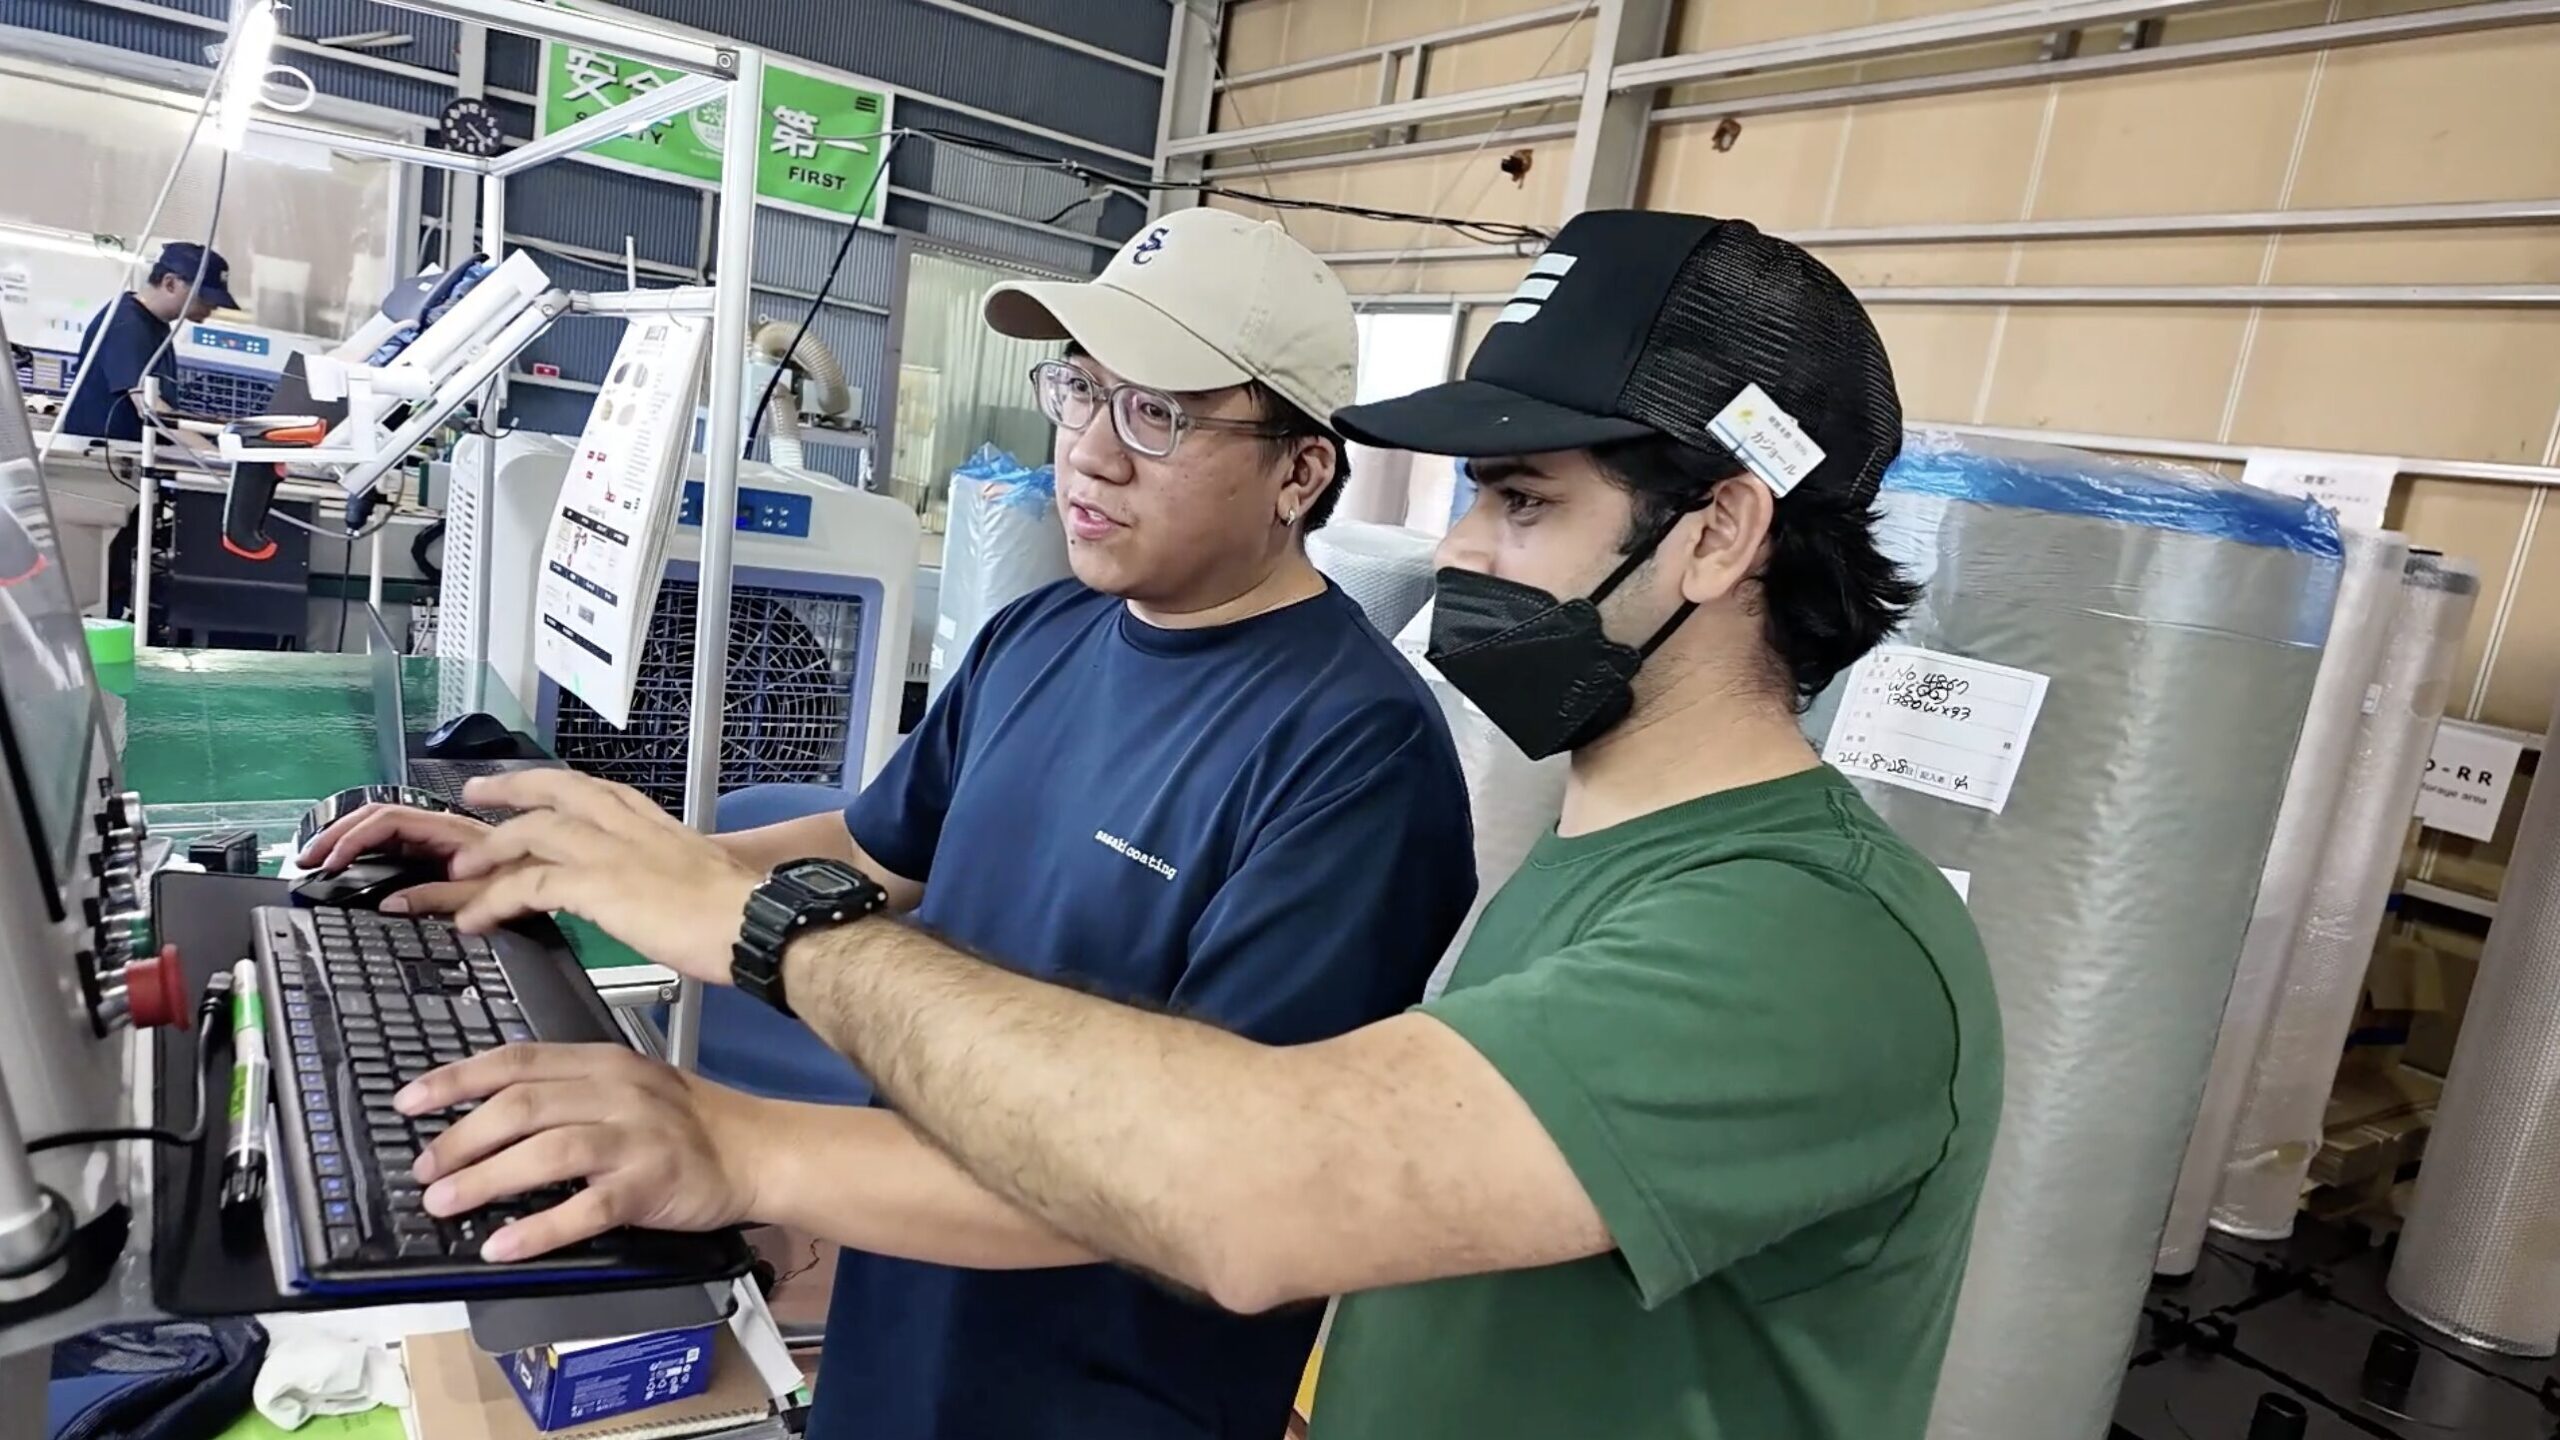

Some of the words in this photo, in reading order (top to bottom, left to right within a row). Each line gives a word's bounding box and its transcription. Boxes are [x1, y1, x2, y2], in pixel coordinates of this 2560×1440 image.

[770, 105, 869, 157] 第一
[788, 166, 846, 190] FIRST
[1750, 431, 1797, 475] カジョール
[2420, 782, 2458, 798] torage
